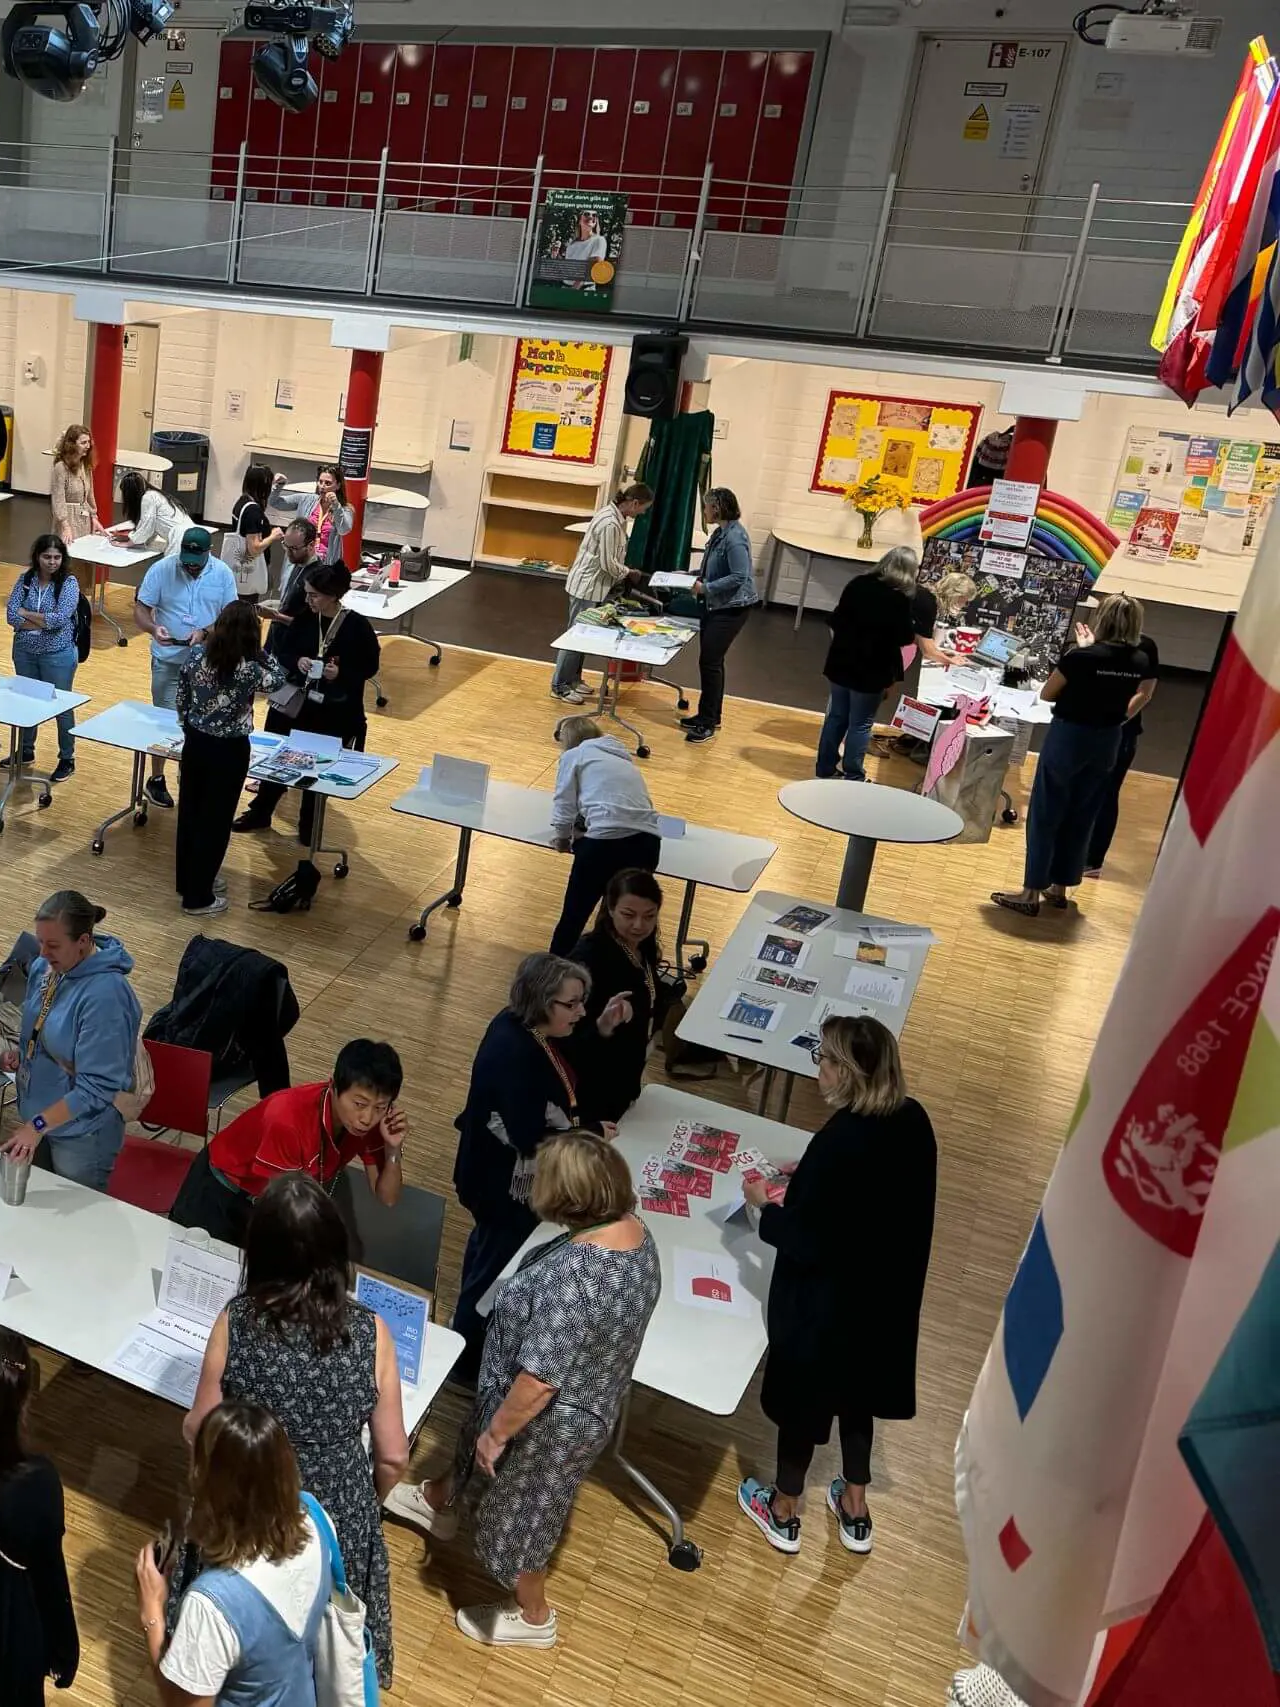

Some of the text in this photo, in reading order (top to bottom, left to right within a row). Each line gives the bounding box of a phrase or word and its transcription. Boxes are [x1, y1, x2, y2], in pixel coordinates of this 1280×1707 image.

[1019, 48, 1051, 58] E-107
[526, 346, 565, 363] Math
[519, 358, 606, 381] Department
[673, 1125, 688, 1139] PCG
[667, 1142, 683, 1156] PCG
[731, 1152, 753, 1166] PCG
[643, 1161, 658, 1175] PCG
[402, 1332, 417, 1341] Jazz
